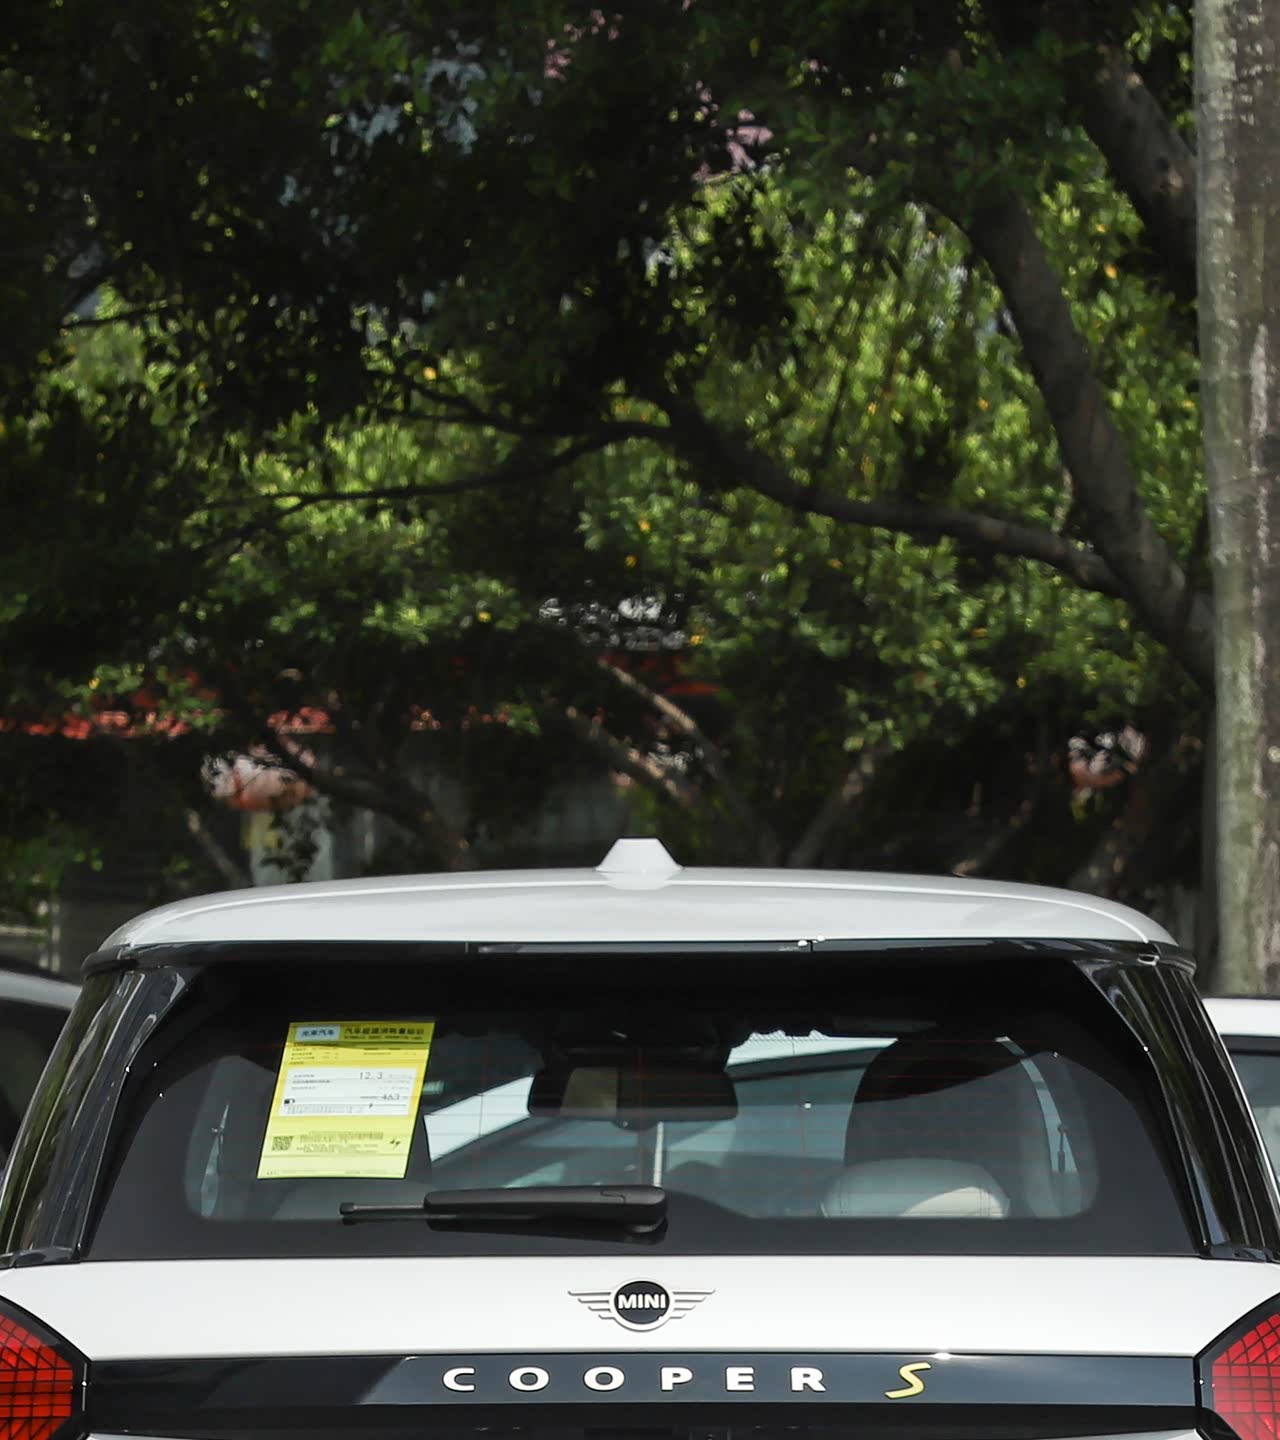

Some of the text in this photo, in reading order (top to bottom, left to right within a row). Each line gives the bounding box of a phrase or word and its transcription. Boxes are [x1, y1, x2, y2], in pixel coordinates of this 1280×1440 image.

[618, 1293, 666, 1309] MINI
[441, 1361, 932, 1400] COOPER S
